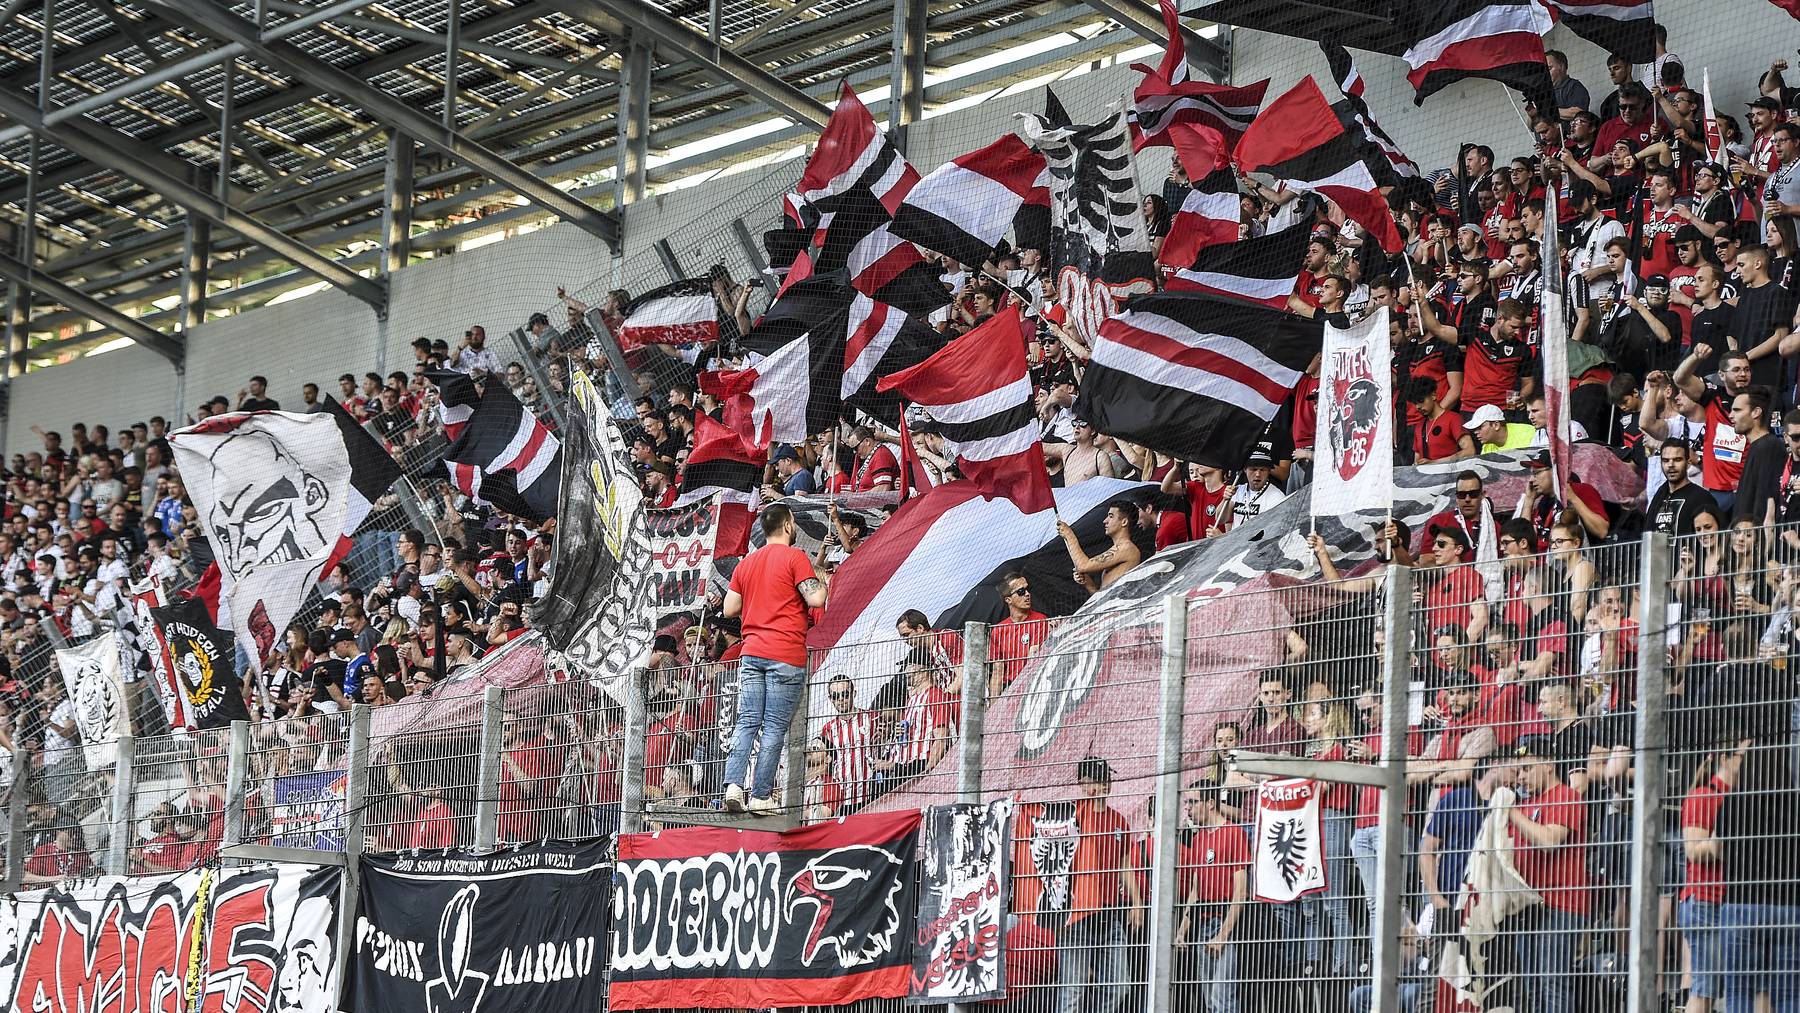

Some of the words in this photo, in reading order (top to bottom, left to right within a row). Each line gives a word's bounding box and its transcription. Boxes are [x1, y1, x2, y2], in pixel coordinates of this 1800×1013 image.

[1333, 343, 1372, 382] ADLER
[415, 859, 442, 873] SIND
[491, 852, 539, 872] DIESER
[544, 852, 576, 869] WELT
[493, 936, 595, 987] AARAU
